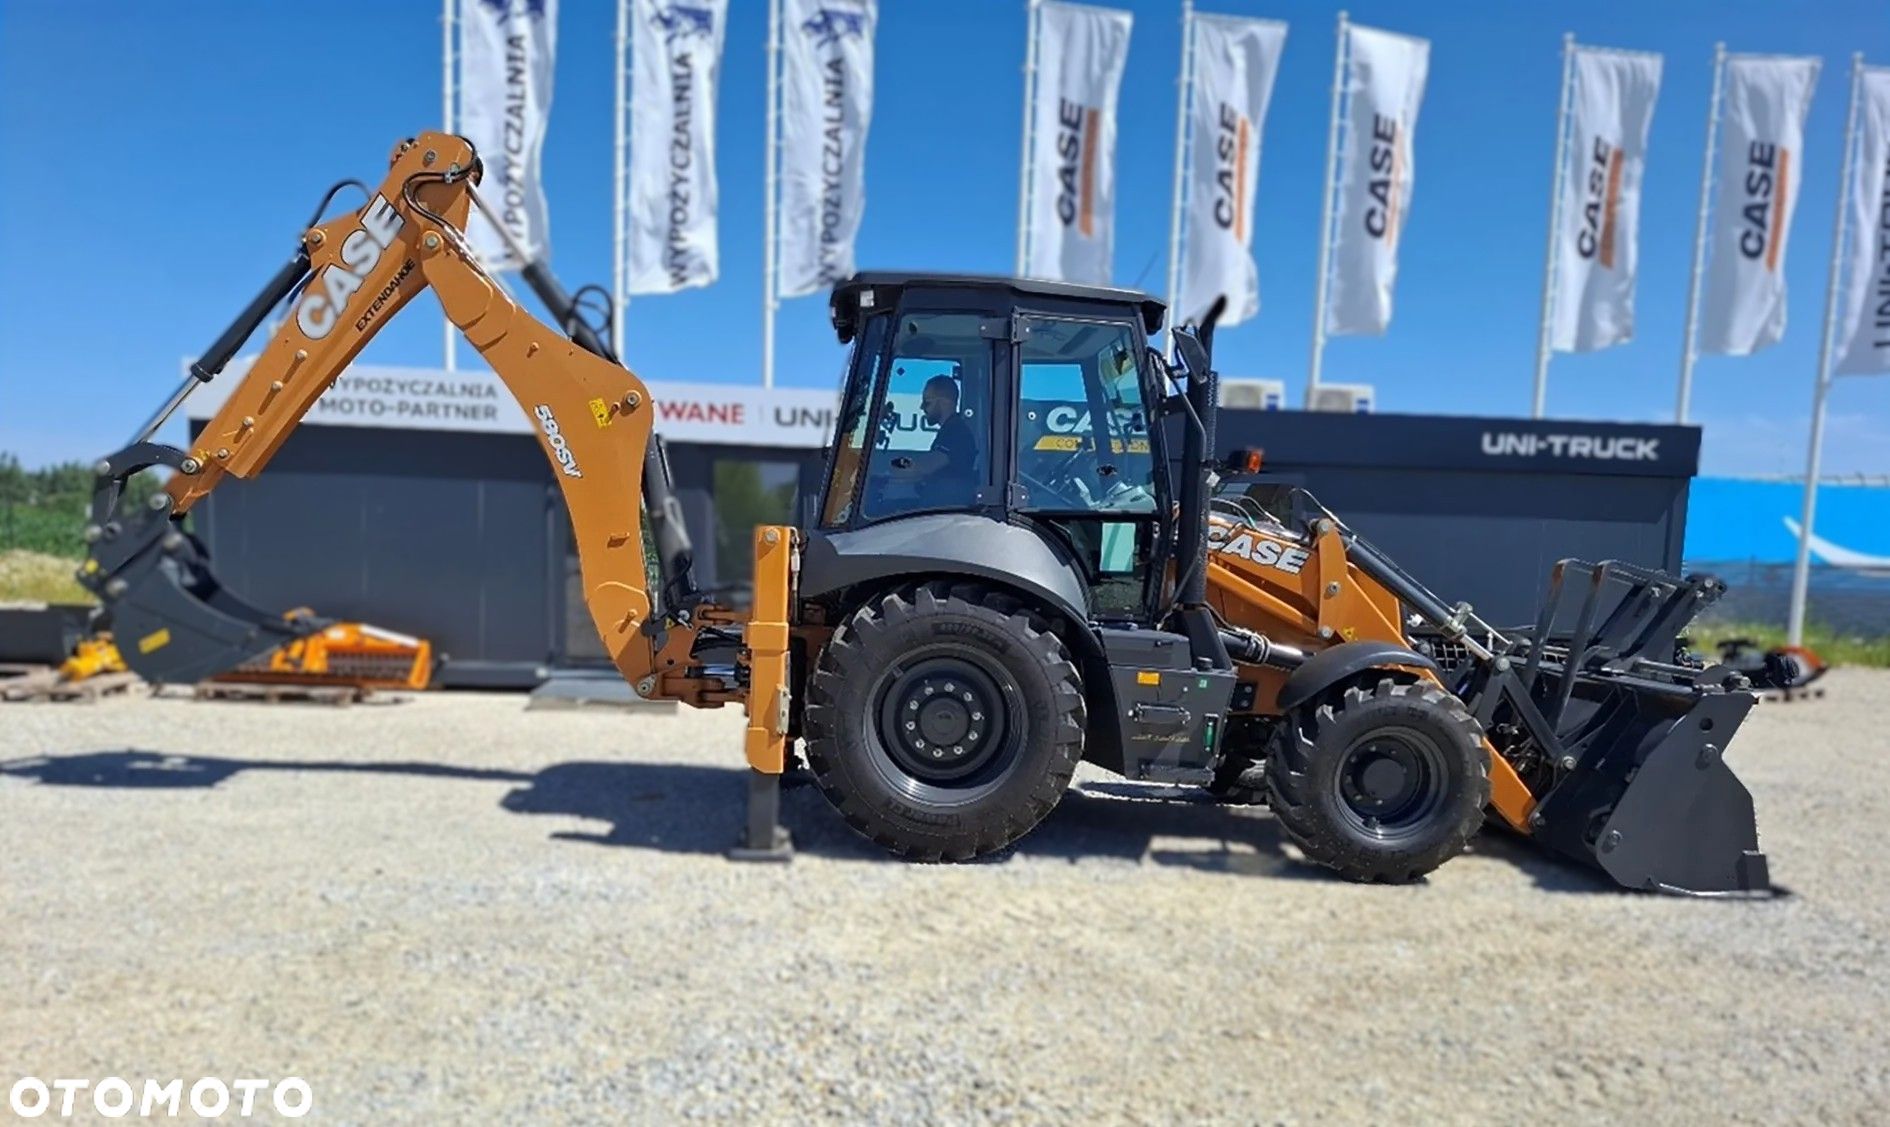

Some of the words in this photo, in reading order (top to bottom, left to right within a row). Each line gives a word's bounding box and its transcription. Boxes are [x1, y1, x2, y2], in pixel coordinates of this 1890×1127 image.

[1056, 99, 1083, 226] CASE
[1214, 103, 1239, 229] CASE
[1365, 115, 1398, 238] CASE
[1578, 136, 1611, 259] CASE
[1740, 140, 1775, 260] CASE
[297, 192, 406, 340] CASE
[355, 258, 415, 332] EXTENDAHOE
[319, 398, 498, 421] MOTO-PARTNER
[1481, 433, 1660, 460] UNI-TRUCK
[1207, 525, 1310, 575] CASE
